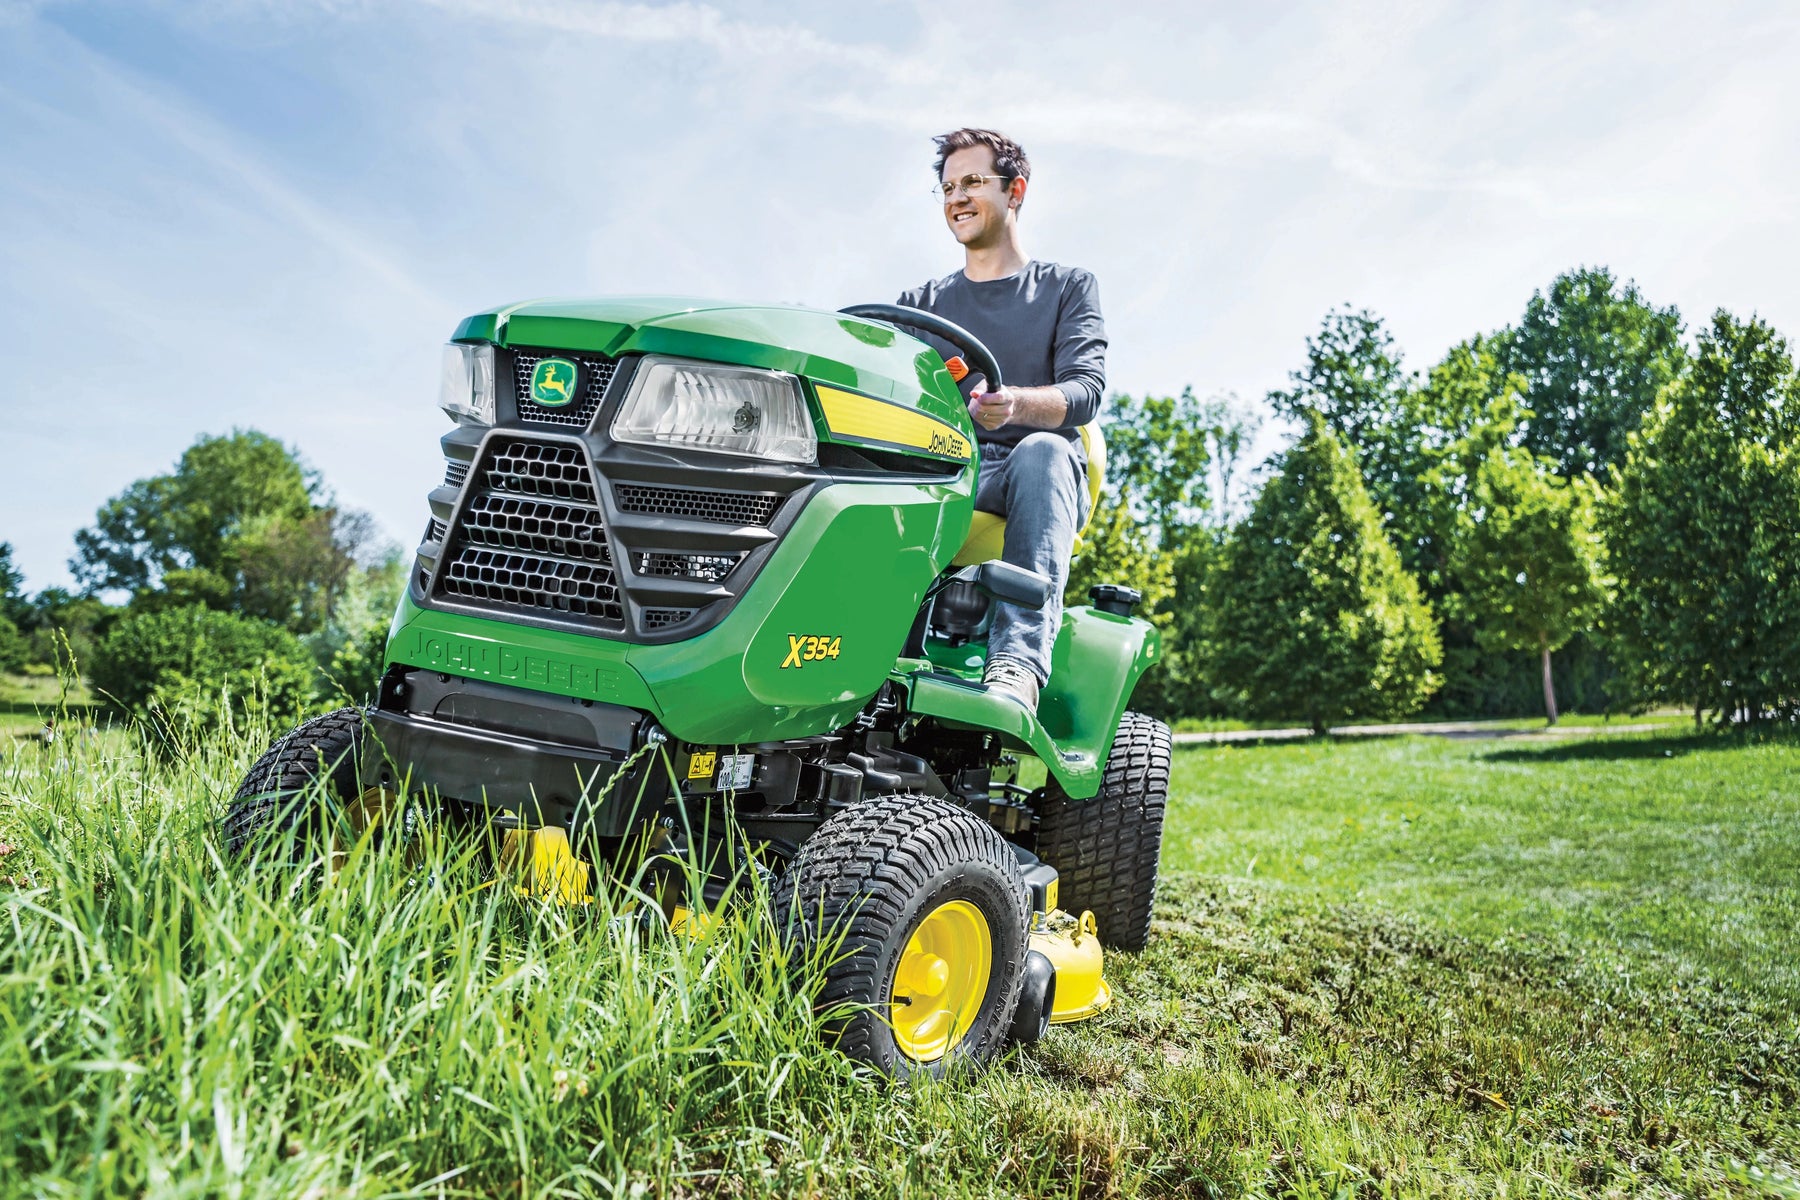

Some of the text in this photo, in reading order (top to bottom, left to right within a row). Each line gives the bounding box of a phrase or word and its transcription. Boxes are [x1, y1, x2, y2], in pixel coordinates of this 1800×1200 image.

[928, 430, 963, 457] JOHN DEERE
[410, 632, 620, 697] JOHN DEERE
[780, 634, 842, 669] X354
